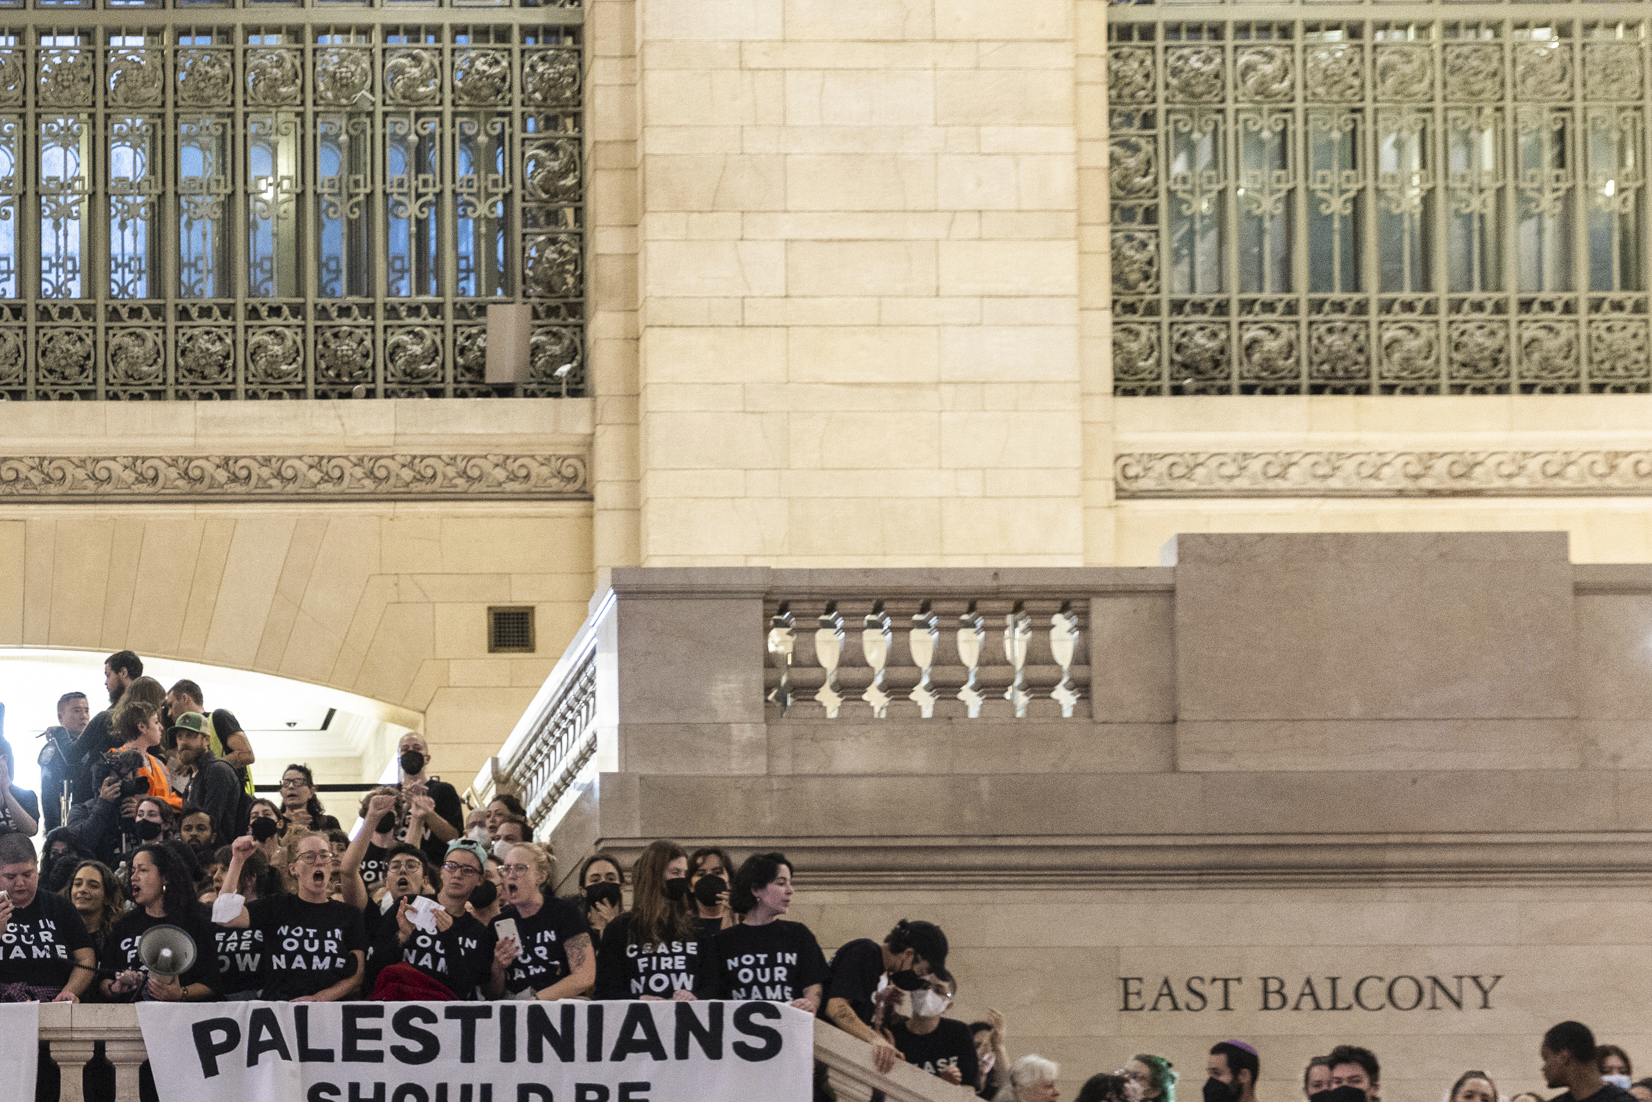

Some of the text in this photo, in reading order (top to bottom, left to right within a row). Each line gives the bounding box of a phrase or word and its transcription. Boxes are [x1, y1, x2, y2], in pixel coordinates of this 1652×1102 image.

[6, 917, 57, 934] OT IN
[276, 924, 318, 939] NOT
[1, 930, 55, 945] OUR
[214, 929, 264, 943] EASE
[535, 930, 557, 944] IN
[216, 940, 254, 954] IRE
[282, 937, 339, 955] OUR
[625, 940, 699, 958] CEASE
[271, 953, 347, 971] NAME
[637, 955, 688, 974] FIRE
[726, 951, 798, 972] NOT IN
[630, 971, 696, 994] NOW
[737, 965, 788, 984] OUR
[731, 983, 794, 1002] NAME
[1117, 973, 1506, 1013] EAST BALCONY
[190, 1000, 784, 1079] PALESTINIANS
